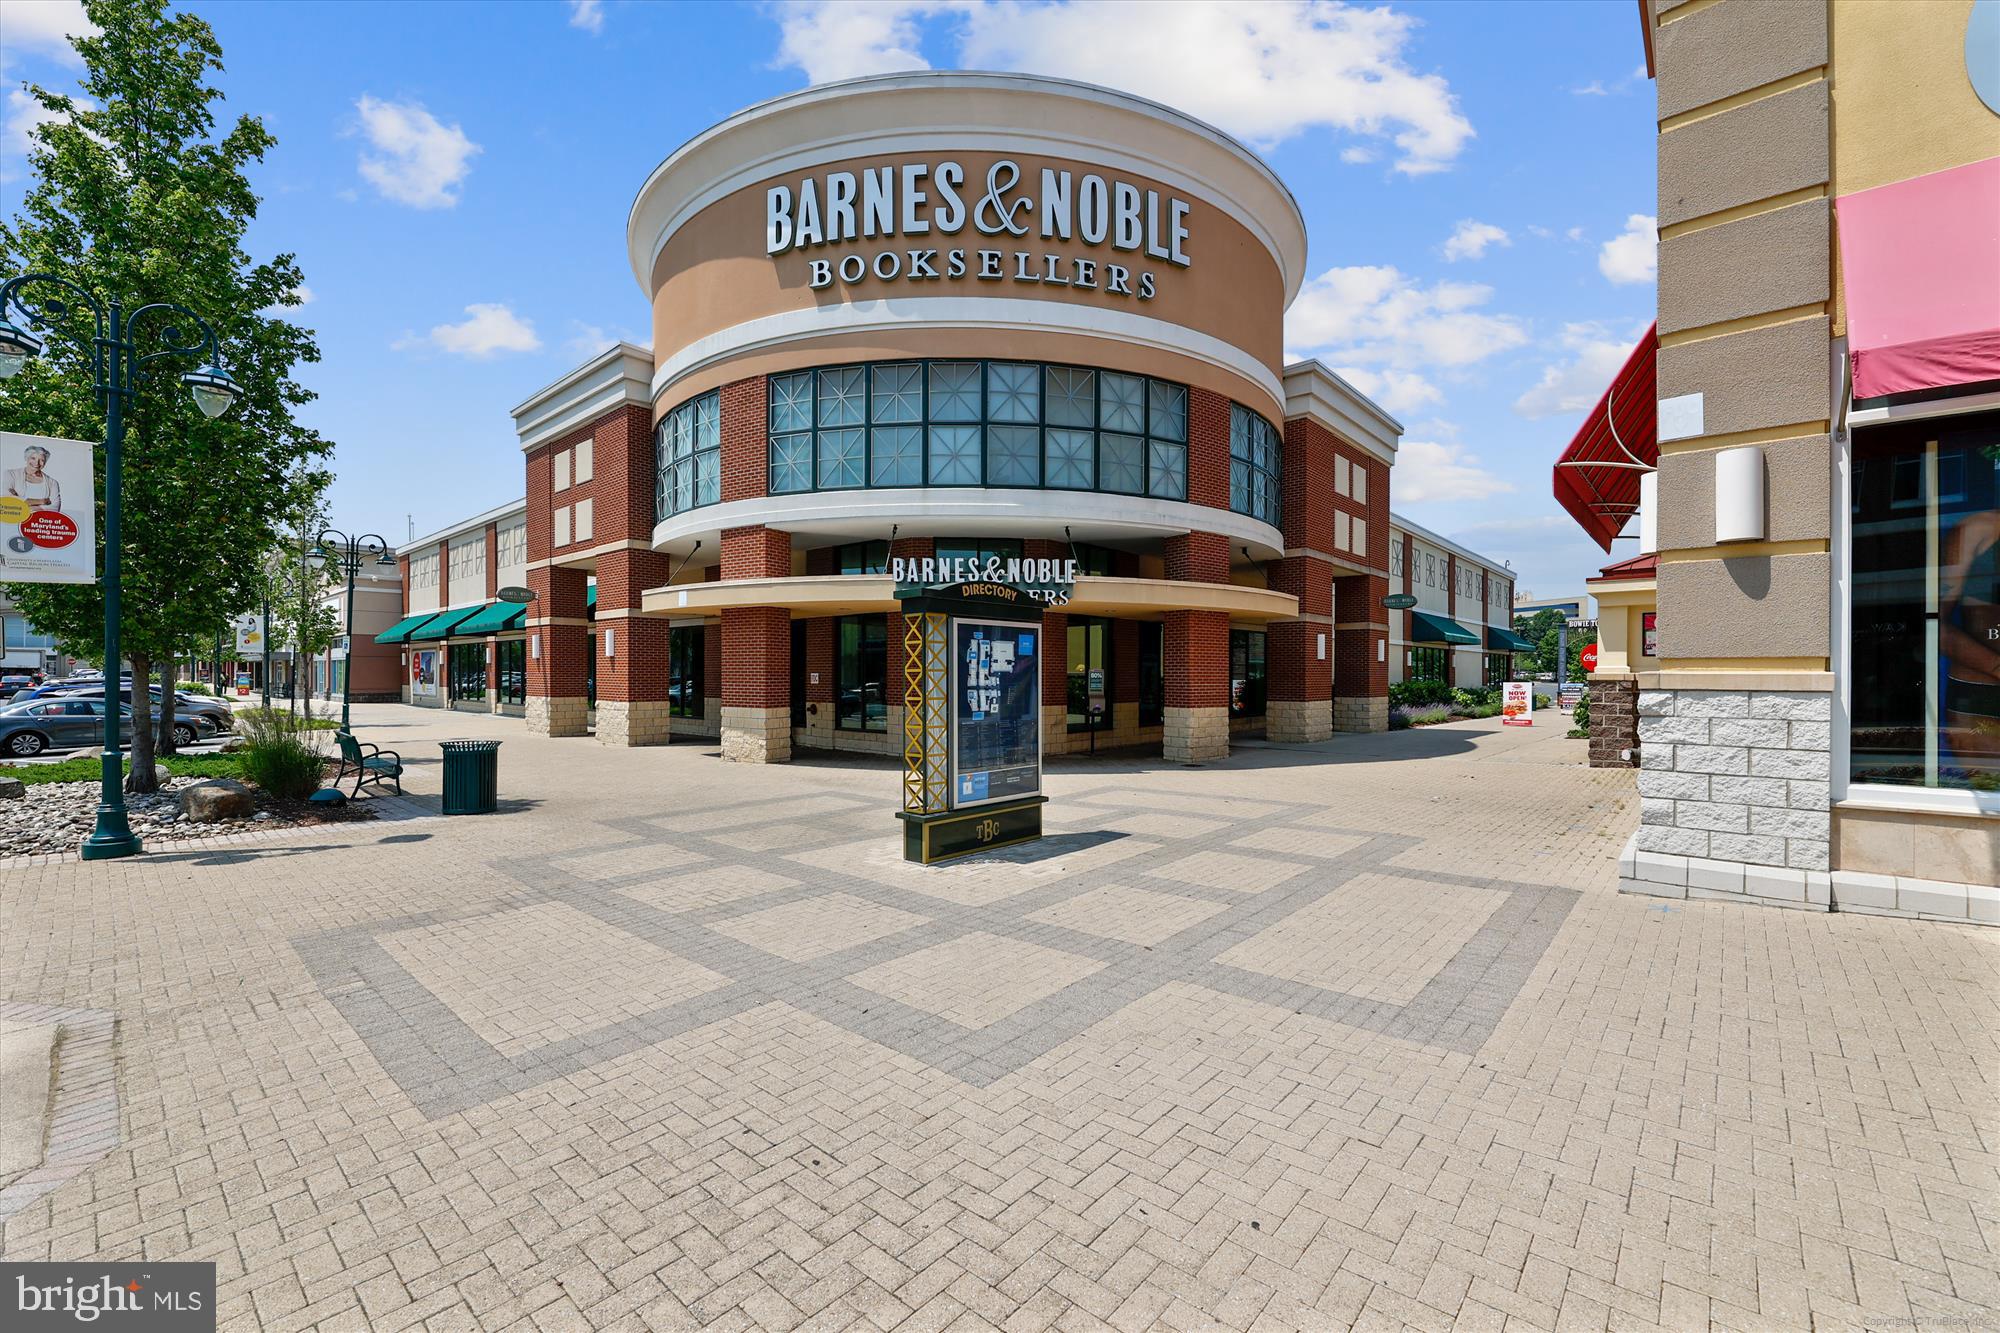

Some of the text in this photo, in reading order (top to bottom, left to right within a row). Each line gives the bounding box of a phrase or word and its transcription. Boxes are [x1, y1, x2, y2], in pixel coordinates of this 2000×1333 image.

[767, 159, 1192, 268] BARNES & NOBLE
[808, 248, 1157, 300] BOOKSELLERS
[24, 527, 50, 535] leading
[31, 522, 69, 531] Maryland's
[892, 557, 979, 584] BARNES
[1007, 558, 1077, 584] NOBLE
[961, 585, 1018, 602] DIRECTORY
[1026, 589, 1069, 606] ERS
[1569, 620, 1590, 628] BOWIE
[976, 819, 1000, 841] TBC
